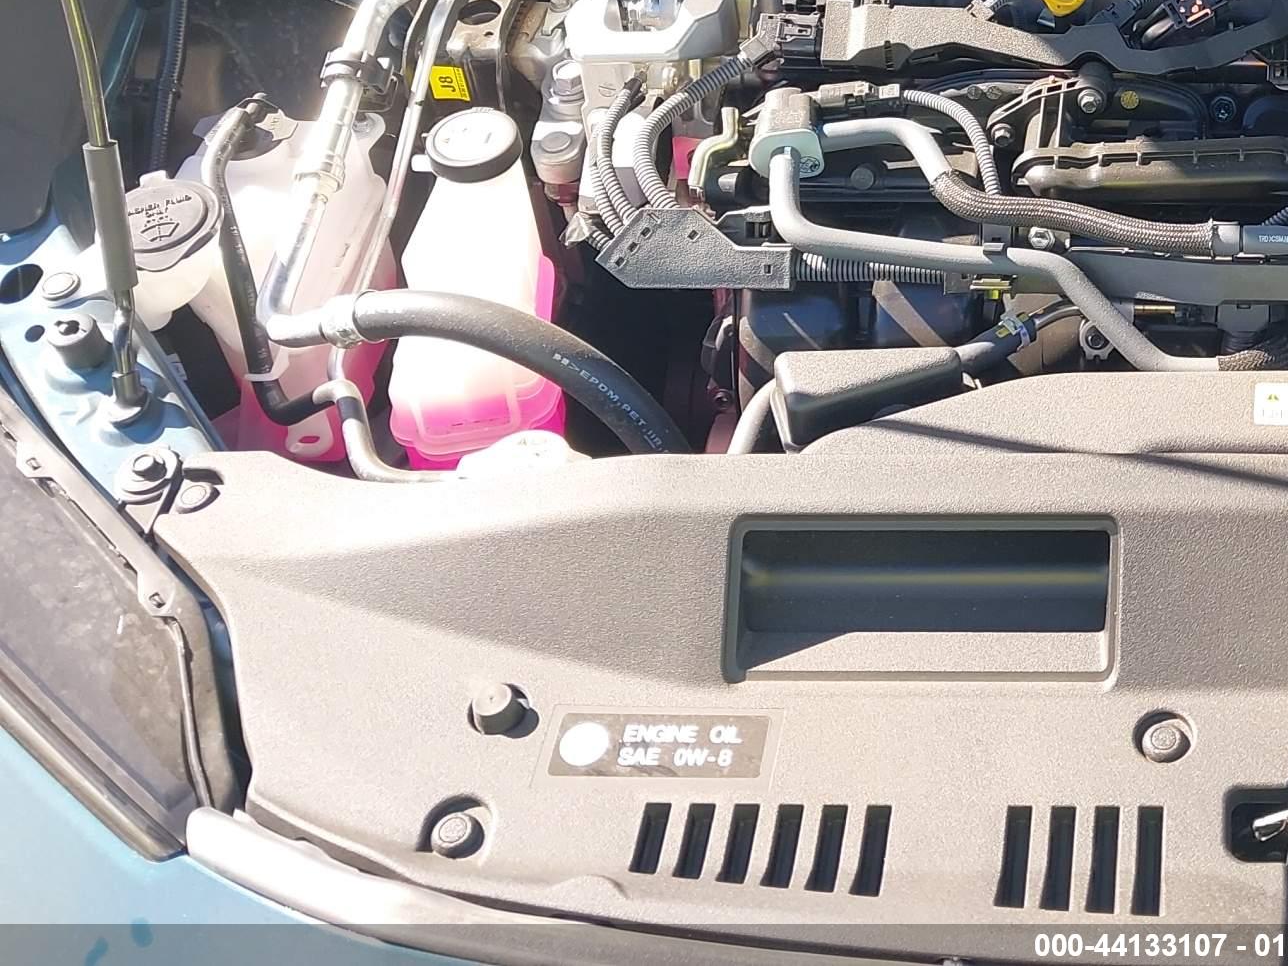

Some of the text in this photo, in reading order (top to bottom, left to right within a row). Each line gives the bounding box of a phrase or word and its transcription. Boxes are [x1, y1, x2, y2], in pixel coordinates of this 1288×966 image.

[438, 75, 457, 93] J8
[622, 724, 743, 744] ENGINE OIL
[617, 747, 734, 767] SAE 0W-8
